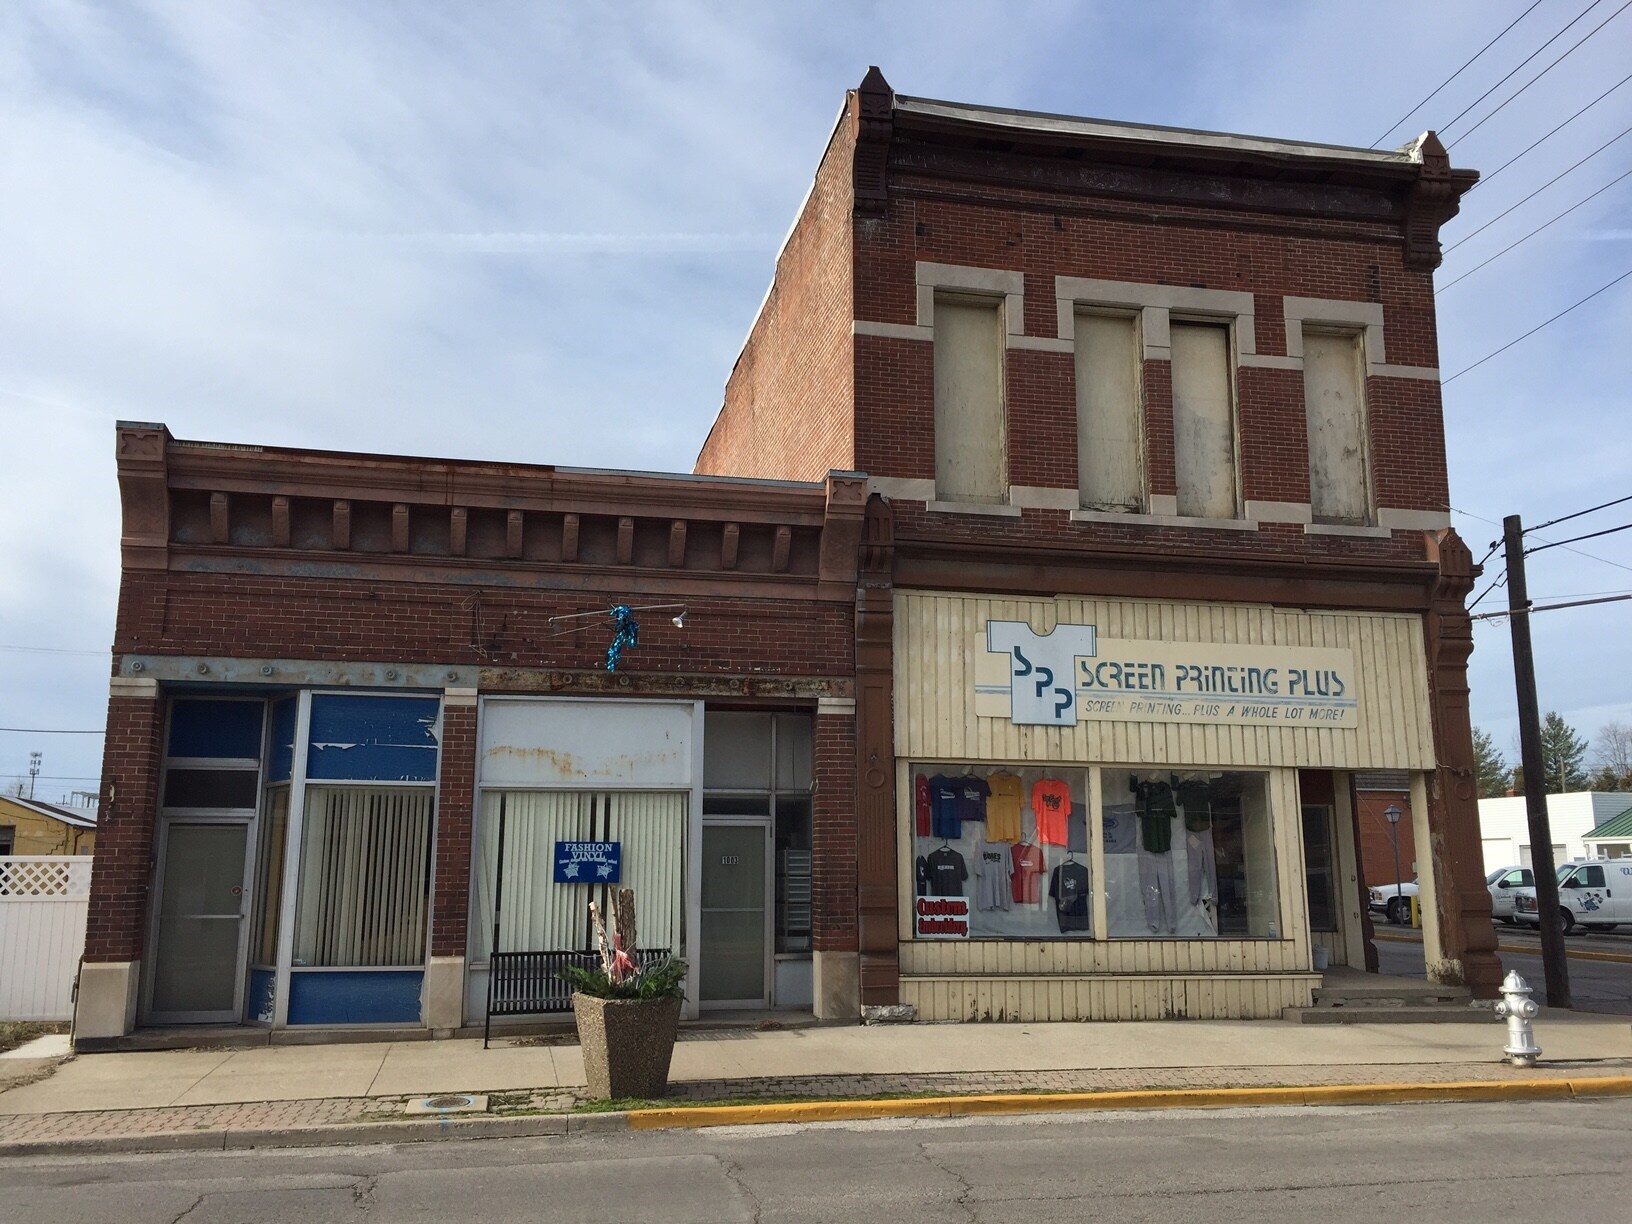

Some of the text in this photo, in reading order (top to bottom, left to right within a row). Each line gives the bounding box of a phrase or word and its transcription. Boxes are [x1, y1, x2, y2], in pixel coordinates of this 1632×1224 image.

[1013, 645, 1073, 719] SPP
[1288, 668, 1346, 697] PLUS
[1085, 699, 1125, 714] SCREE
[1193, 704, 1220, 717] PLUS
[1226, 705, 1236, 718] A
[1240, 706, 1279, 720] WHOLE
[1284, 707, 1305, 720] LOT
[1308, 708, 1345, 722] MORE!
[564, 843, 614, 852] FASHION
[571, 851, 606, 860] VINYL
[917, 898, 969, 916] Custom
